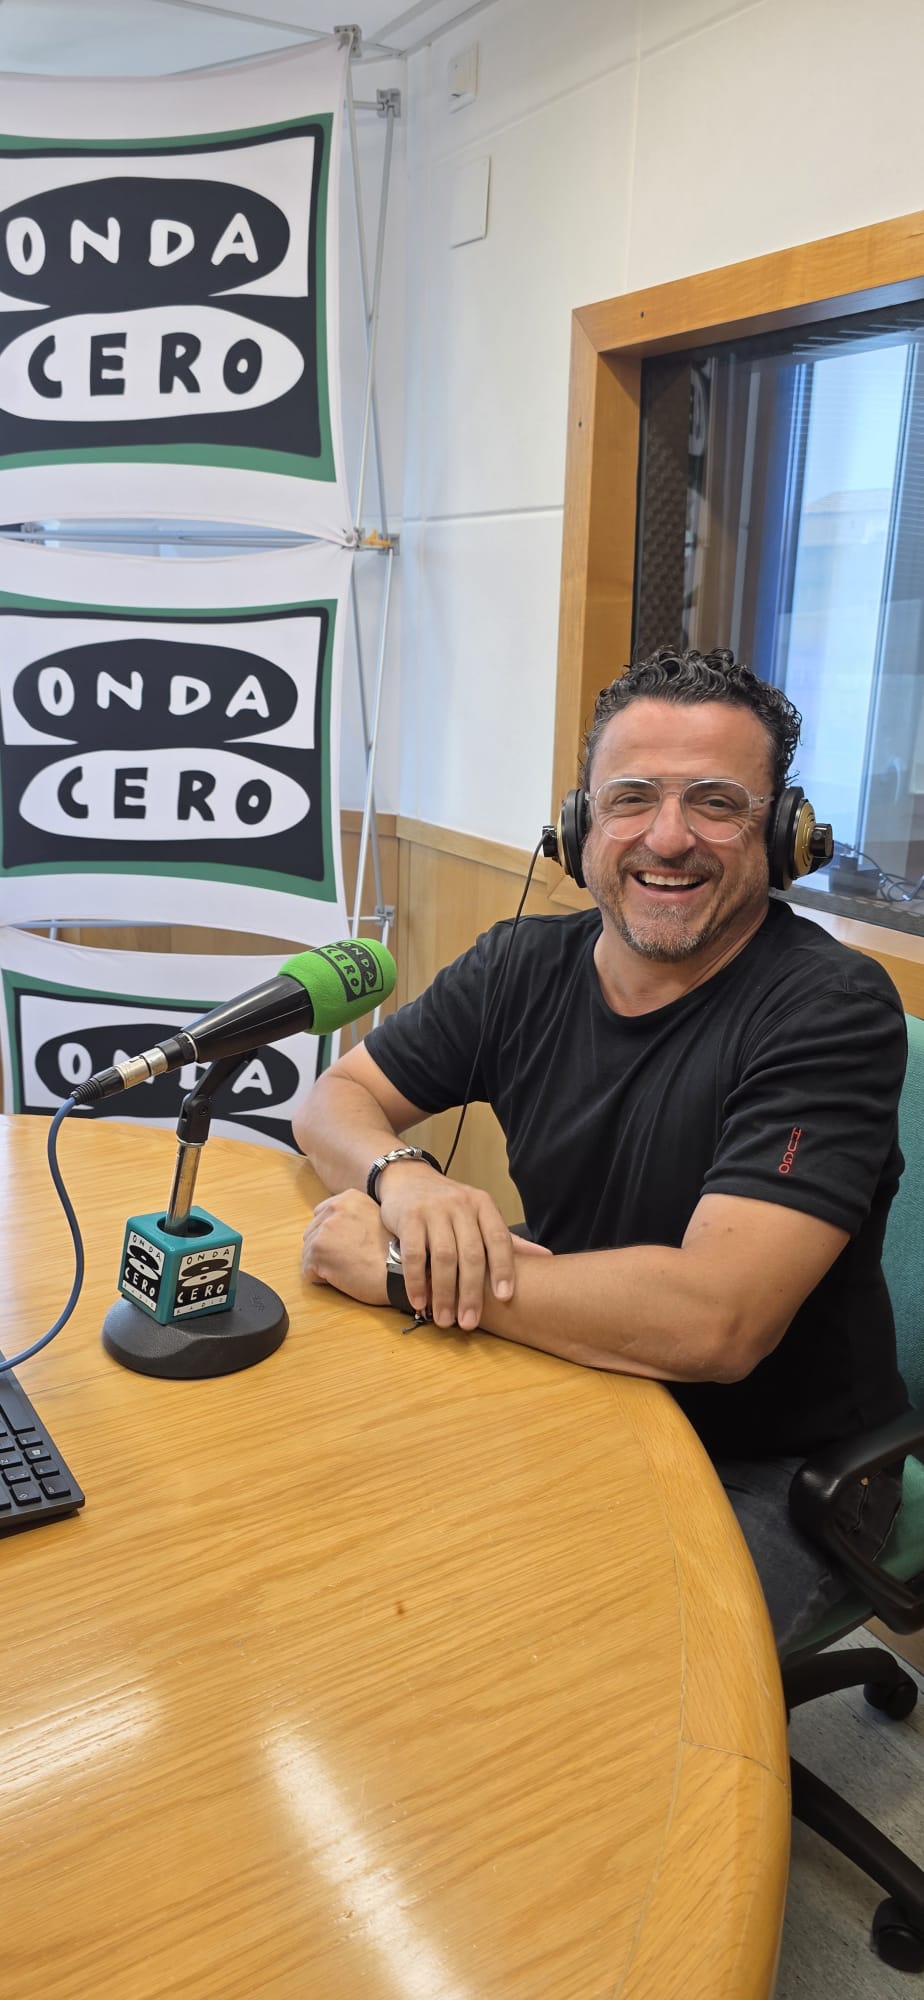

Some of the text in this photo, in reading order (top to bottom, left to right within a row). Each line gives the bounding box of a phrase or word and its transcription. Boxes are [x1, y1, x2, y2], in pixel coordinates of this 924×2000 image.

[6, 213, 259, 276] ONDA
[28, 332, 263, 399] CERO
[38, 667, 270, 718] ONDA
[57, 766, 272, 825] CERO
[326, 948, 360, 987] CERO
[340, 942, 375, 983] ONDA
[778, 1127, 803, 1174] HUGO
[132, 1234, 161, 1260] ONDA
[186, 1248, 230, 1265] ONDA
[125, 1267, 156, 1297] CERO
[177, 1283, 225, 1304] CERO
